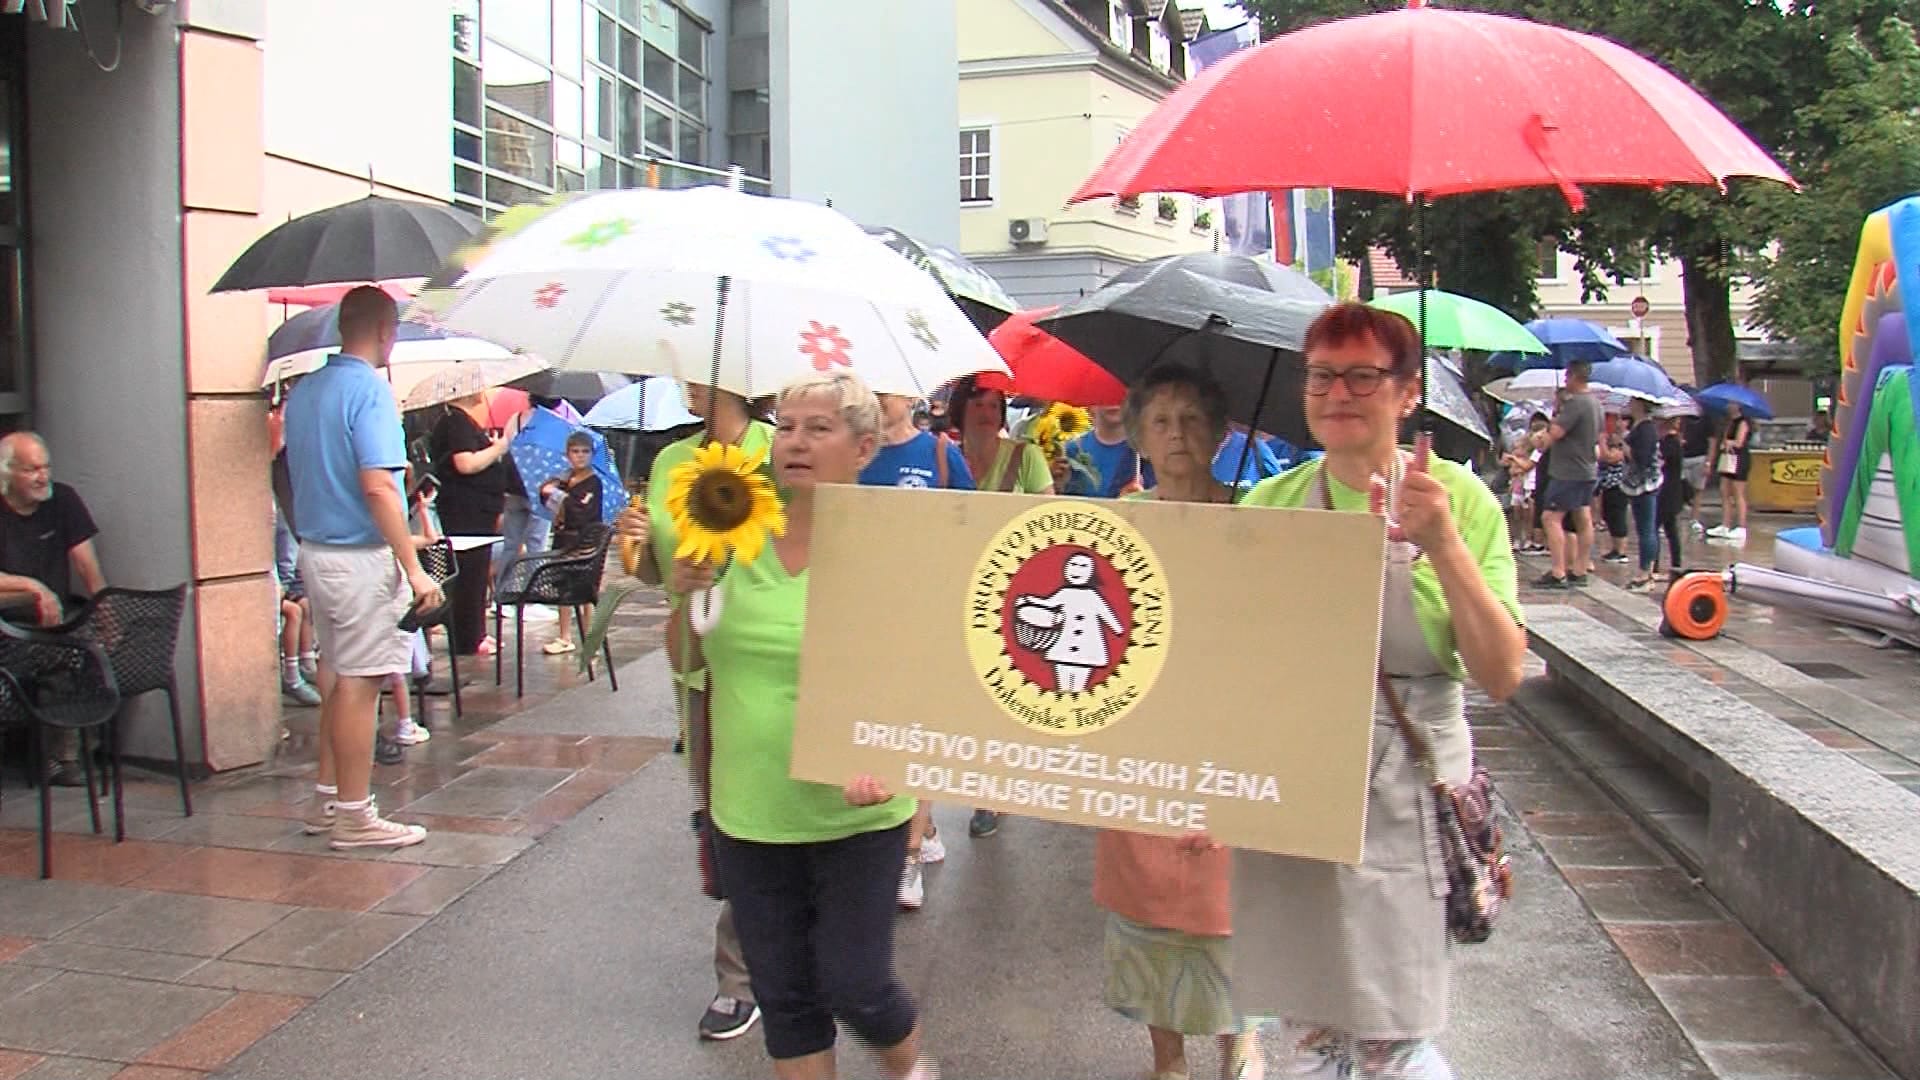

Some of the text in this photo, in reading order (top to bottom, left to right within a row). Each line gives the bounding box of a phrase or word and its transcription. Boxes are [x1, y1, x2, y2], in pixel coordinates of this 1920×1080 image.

[972, 511, 1166, 649] DRUŠTVO PODEŽELSKIH ŽENA
[984, 666, 1140, 729] Dolenjske Toplice
[852, 720, 1282, 803] DRUŠTVO PODEŽELSKIH ŽENA
[905, 762, 1209, 830] DOLENJSKE TOPLICE
